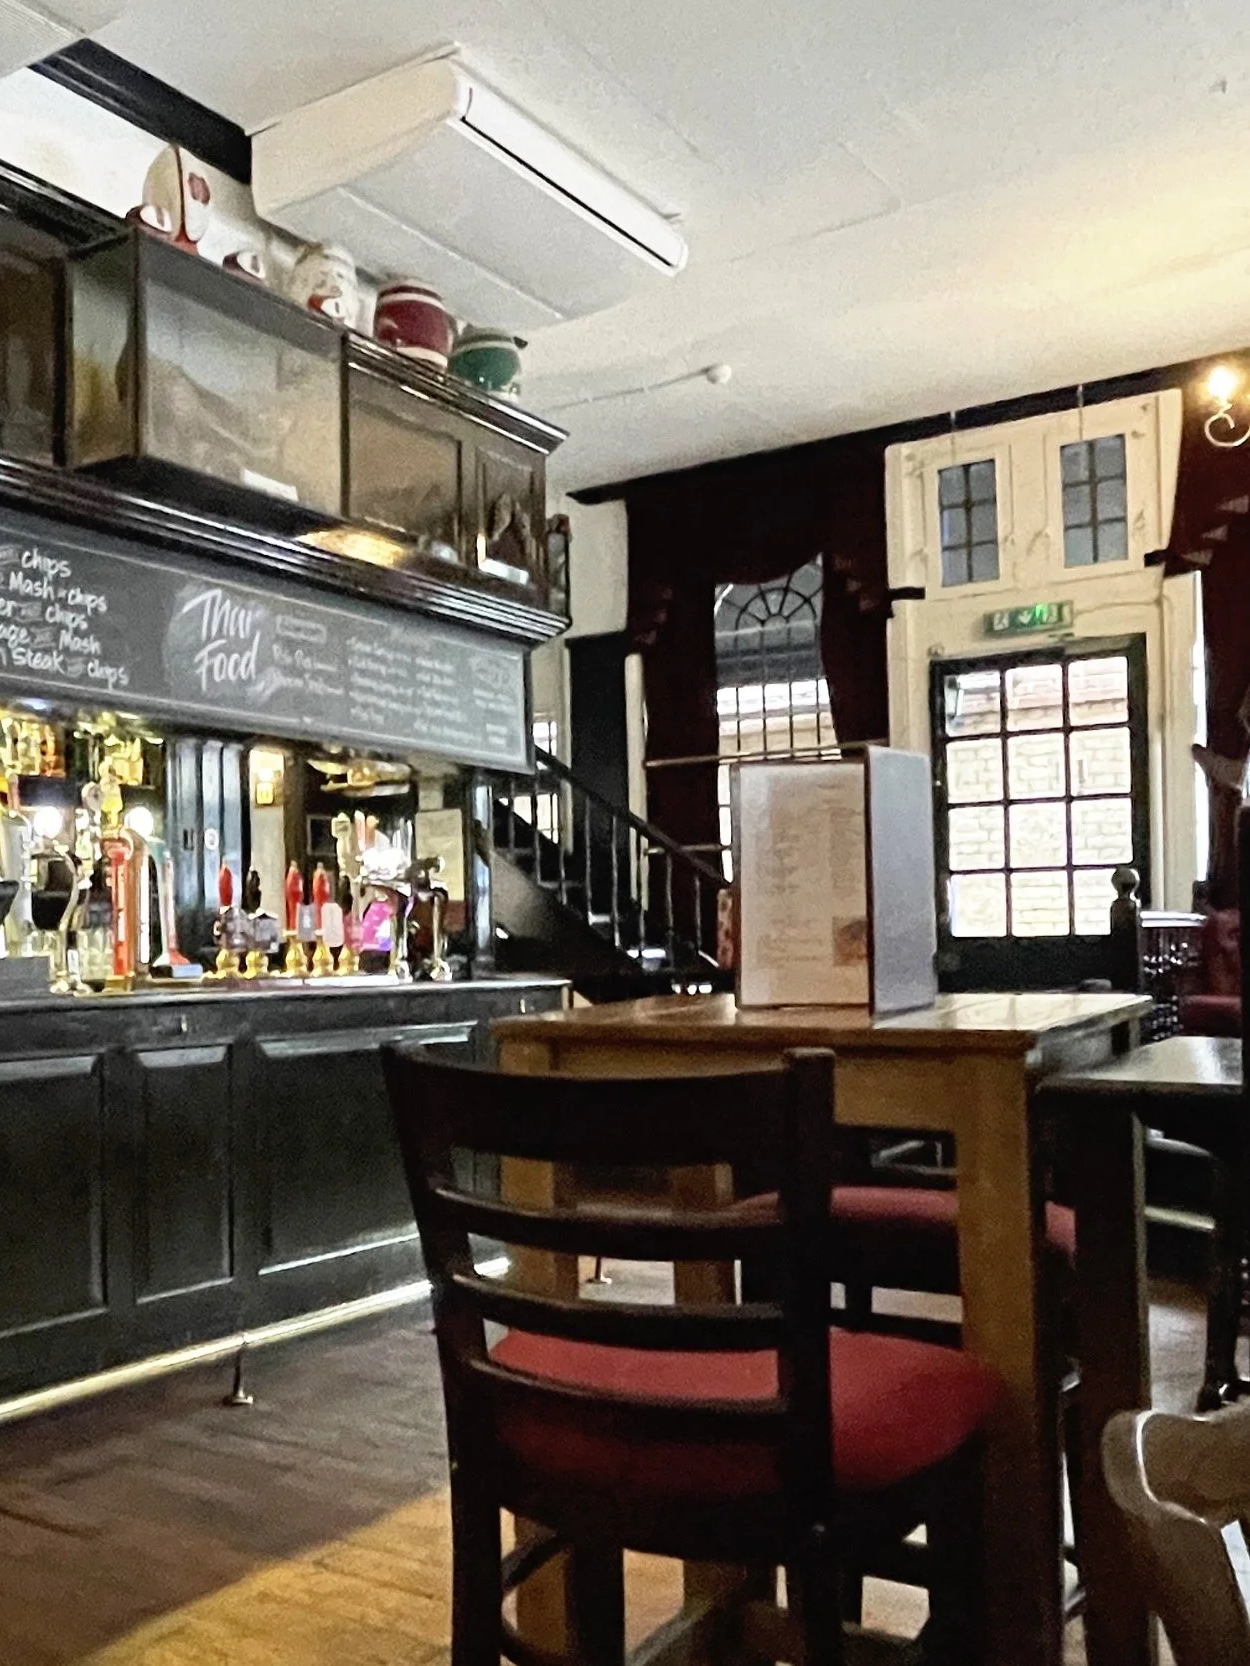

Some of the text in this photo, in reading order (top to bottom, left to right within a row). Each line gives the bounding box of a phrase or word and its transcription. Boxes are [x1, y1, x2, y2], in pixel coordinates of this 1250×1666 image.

[9, 571, 55, 600] Mash
[59, 630, 101, 655] Mash
[12, 647, 65, 674] Steak
[194, 630, 261, 692] Food
